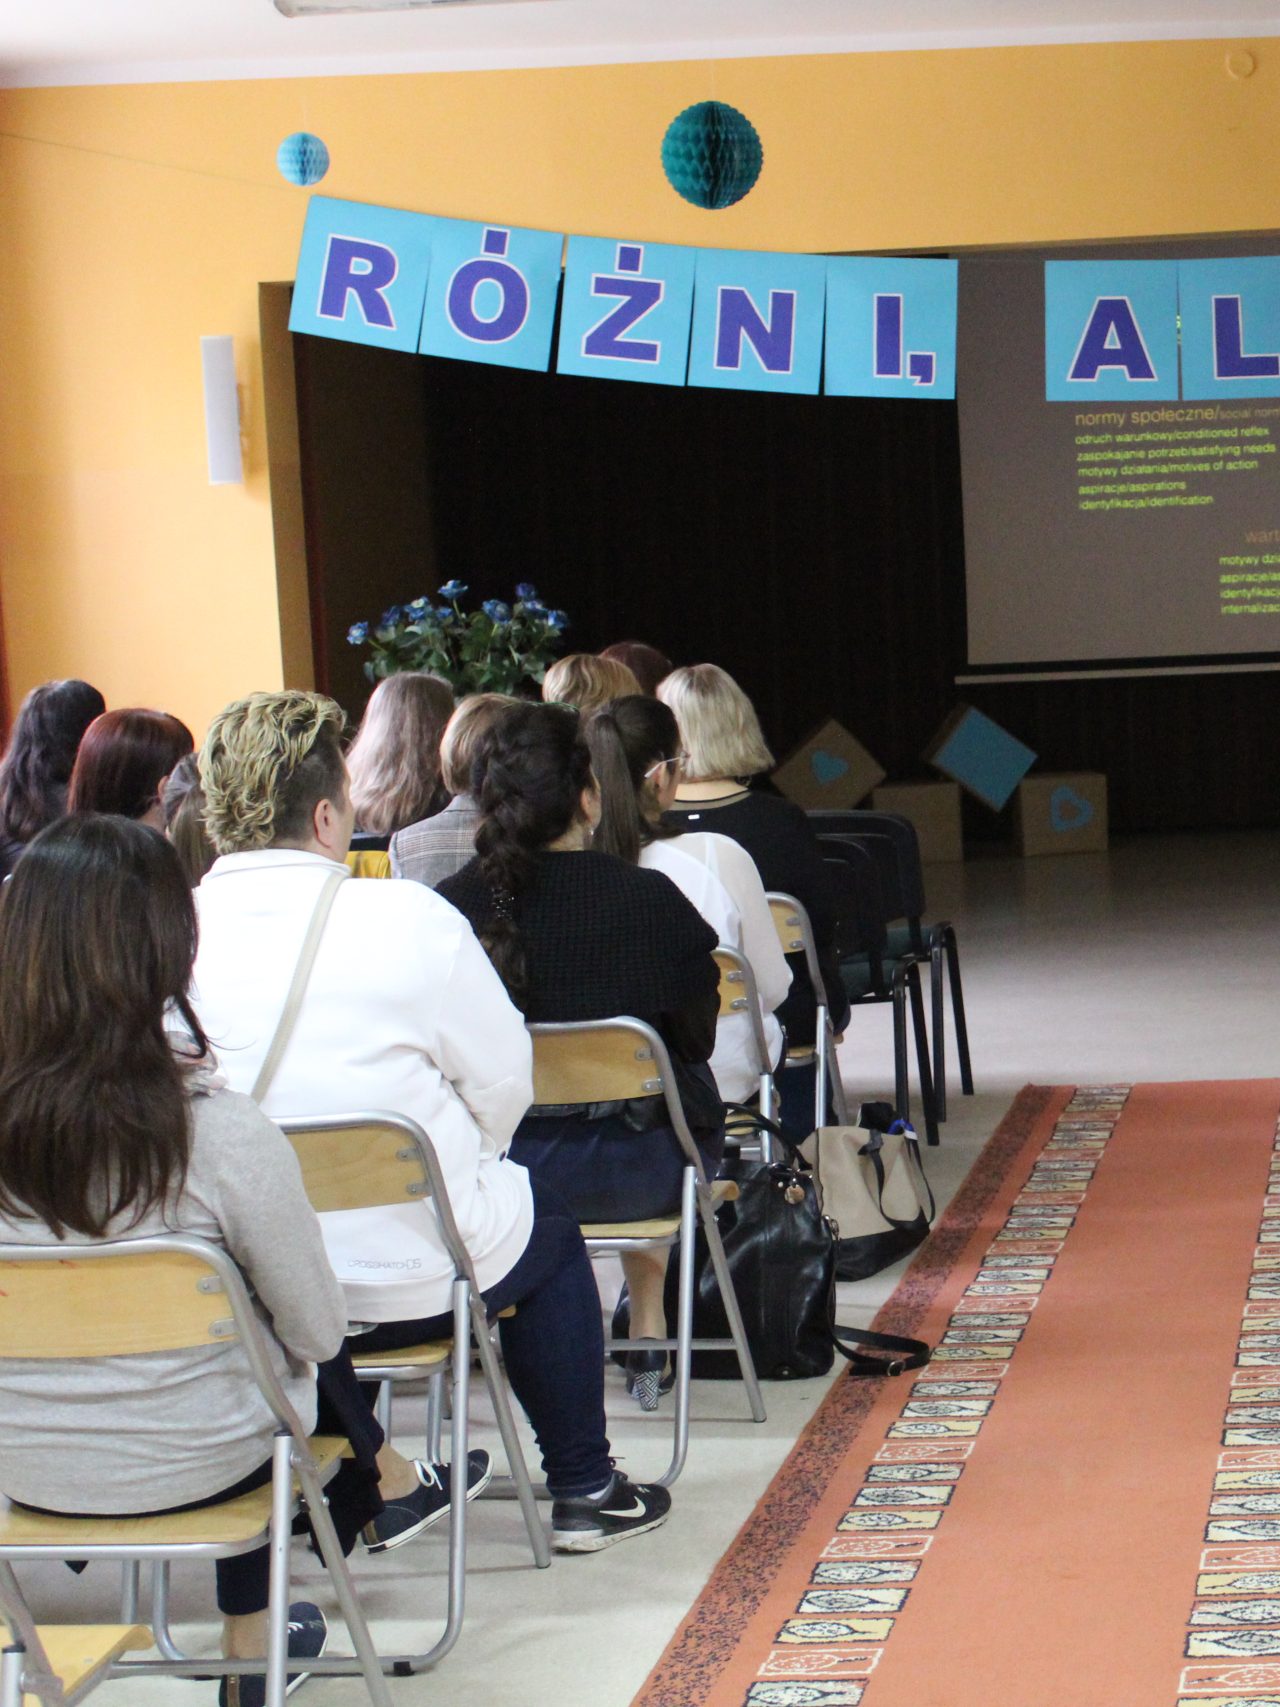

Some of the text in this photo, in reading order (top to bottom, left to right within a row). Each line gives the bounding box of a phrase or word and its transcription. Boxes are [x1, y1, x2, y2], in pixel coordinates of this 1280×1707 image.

[1075, 412, 1125, 428] normy
[1075, 433, 1112, 445] odruch
[1076, 449, 1145, 462] zaspokajanie
[1243, 442, 1276, 454] needs
[1078, 466, 1118, 478] motywy
[1213, 461, 1223, 471] of
[1226, 459, 1259, 471] action
[1219, 556, 1259, 567] motywy
